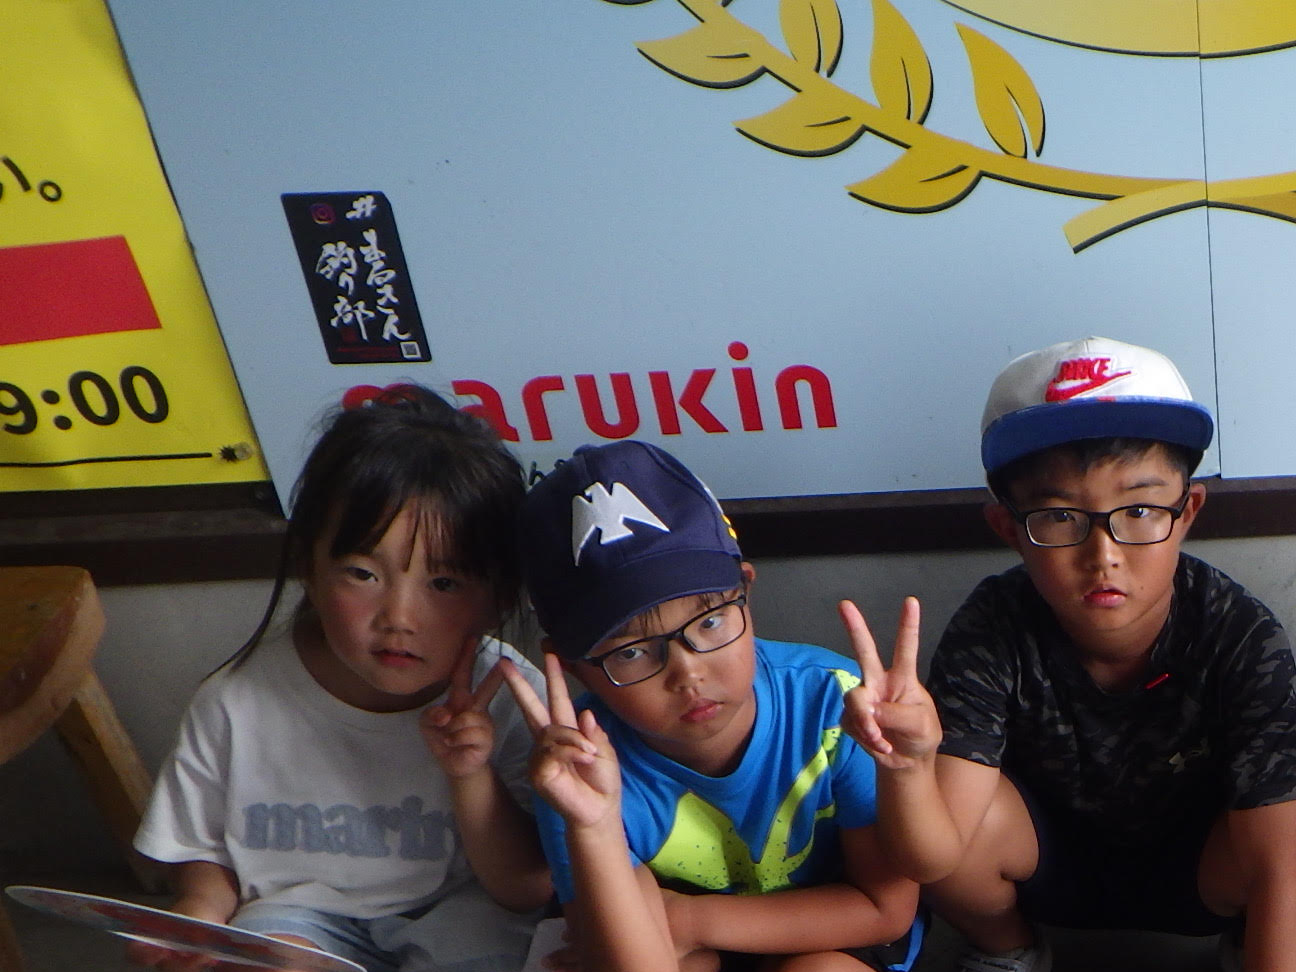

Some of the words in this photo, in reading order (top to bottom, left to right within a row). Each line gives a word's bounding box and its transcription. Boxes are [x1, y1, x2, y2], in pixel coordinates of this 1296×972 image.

[316, 241, 375, 341] 釣り部
[1055, 357, 1111, 382] NIKE
